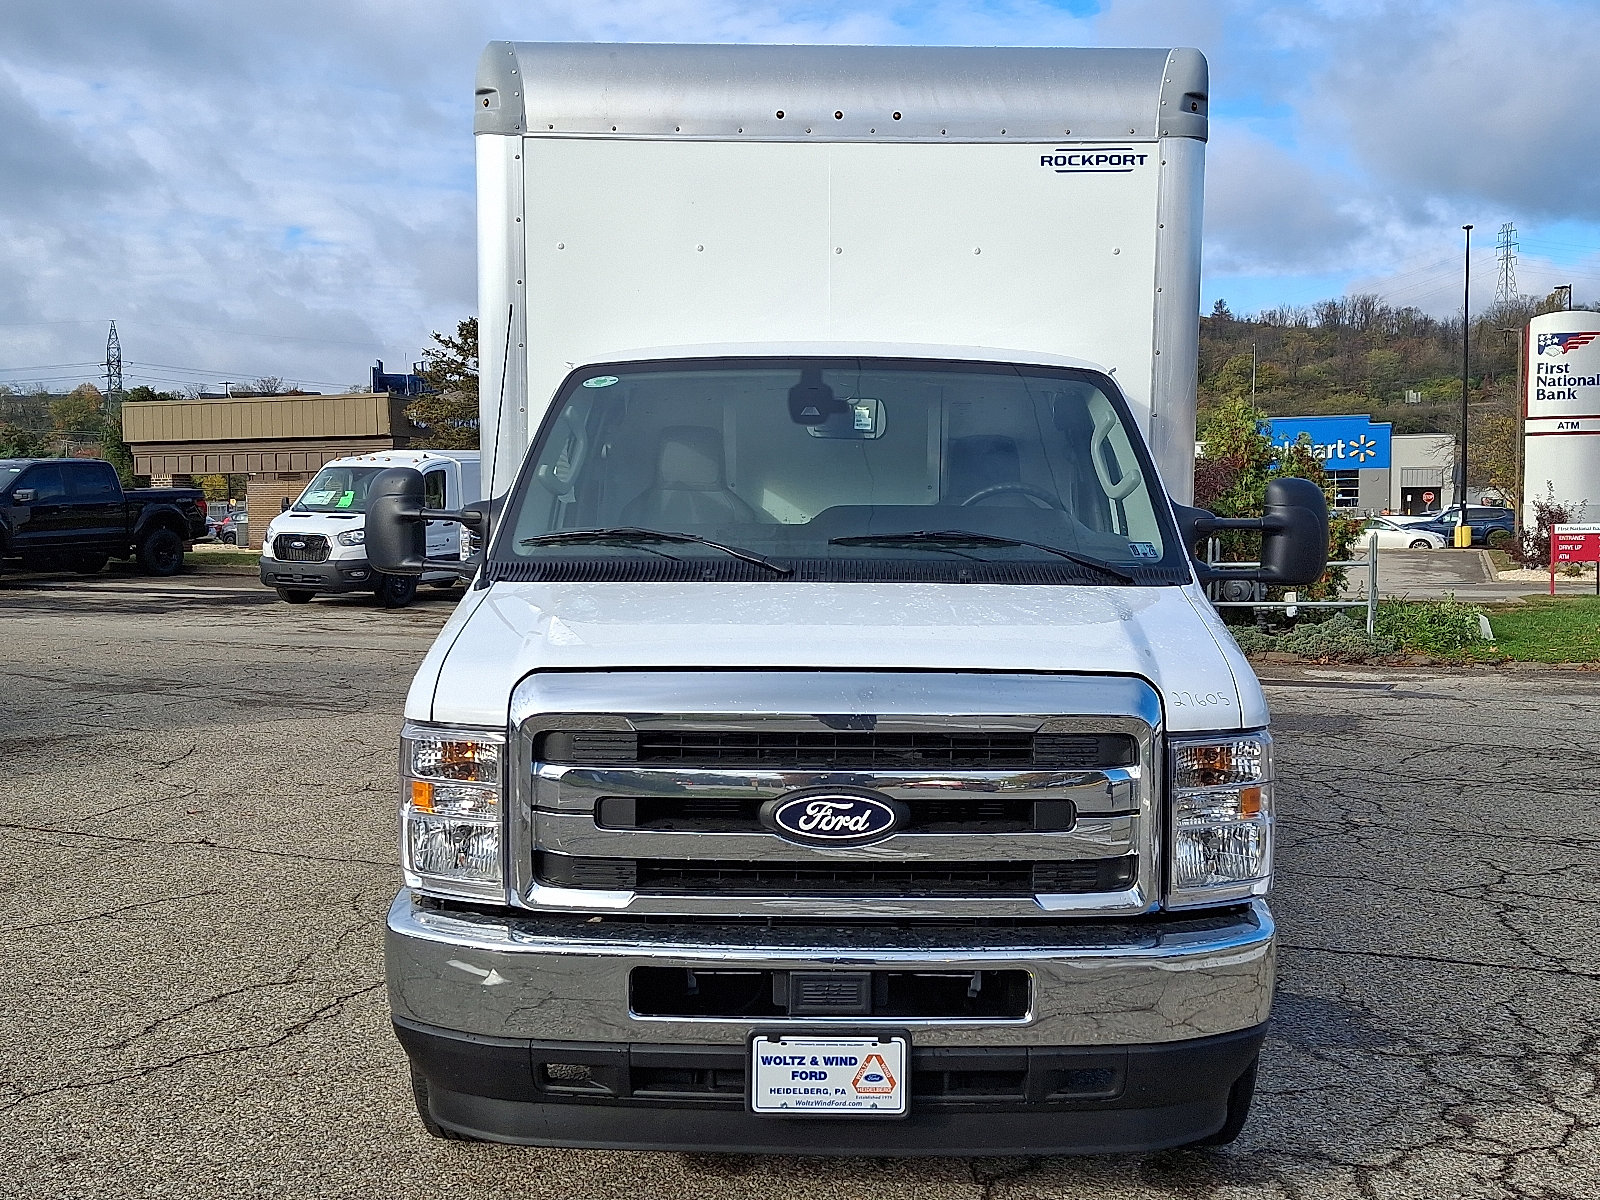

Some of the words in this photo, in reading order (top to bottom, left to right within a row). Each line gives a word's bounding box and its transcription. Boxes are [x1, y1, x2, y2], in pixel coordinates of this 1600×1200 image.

[1040, 154, 1148, 167] ROCKPORT
[1537, 362, 1570, 375] First
[1536, 374, 1600, 388] National
[1536, 388, 1578, 400] Bank
[1557, 421, 1580, 430] ATM
[1171, 691, 1231, 707] 27605
[798, 801, 872, 831] Ford
[760, 1055, 806, 1066] WOLTZ
[809, 1055, 819, 1066] &
[823, 1056, 858, 1067] WIND
[791, 1071, 828, 1081] FORD
[856, 1061, 869, 1080] WOLTZ
[880, 1063, 892, 1078] WIND
[769, 1087, 832, 1096] HEIDELBERG,
